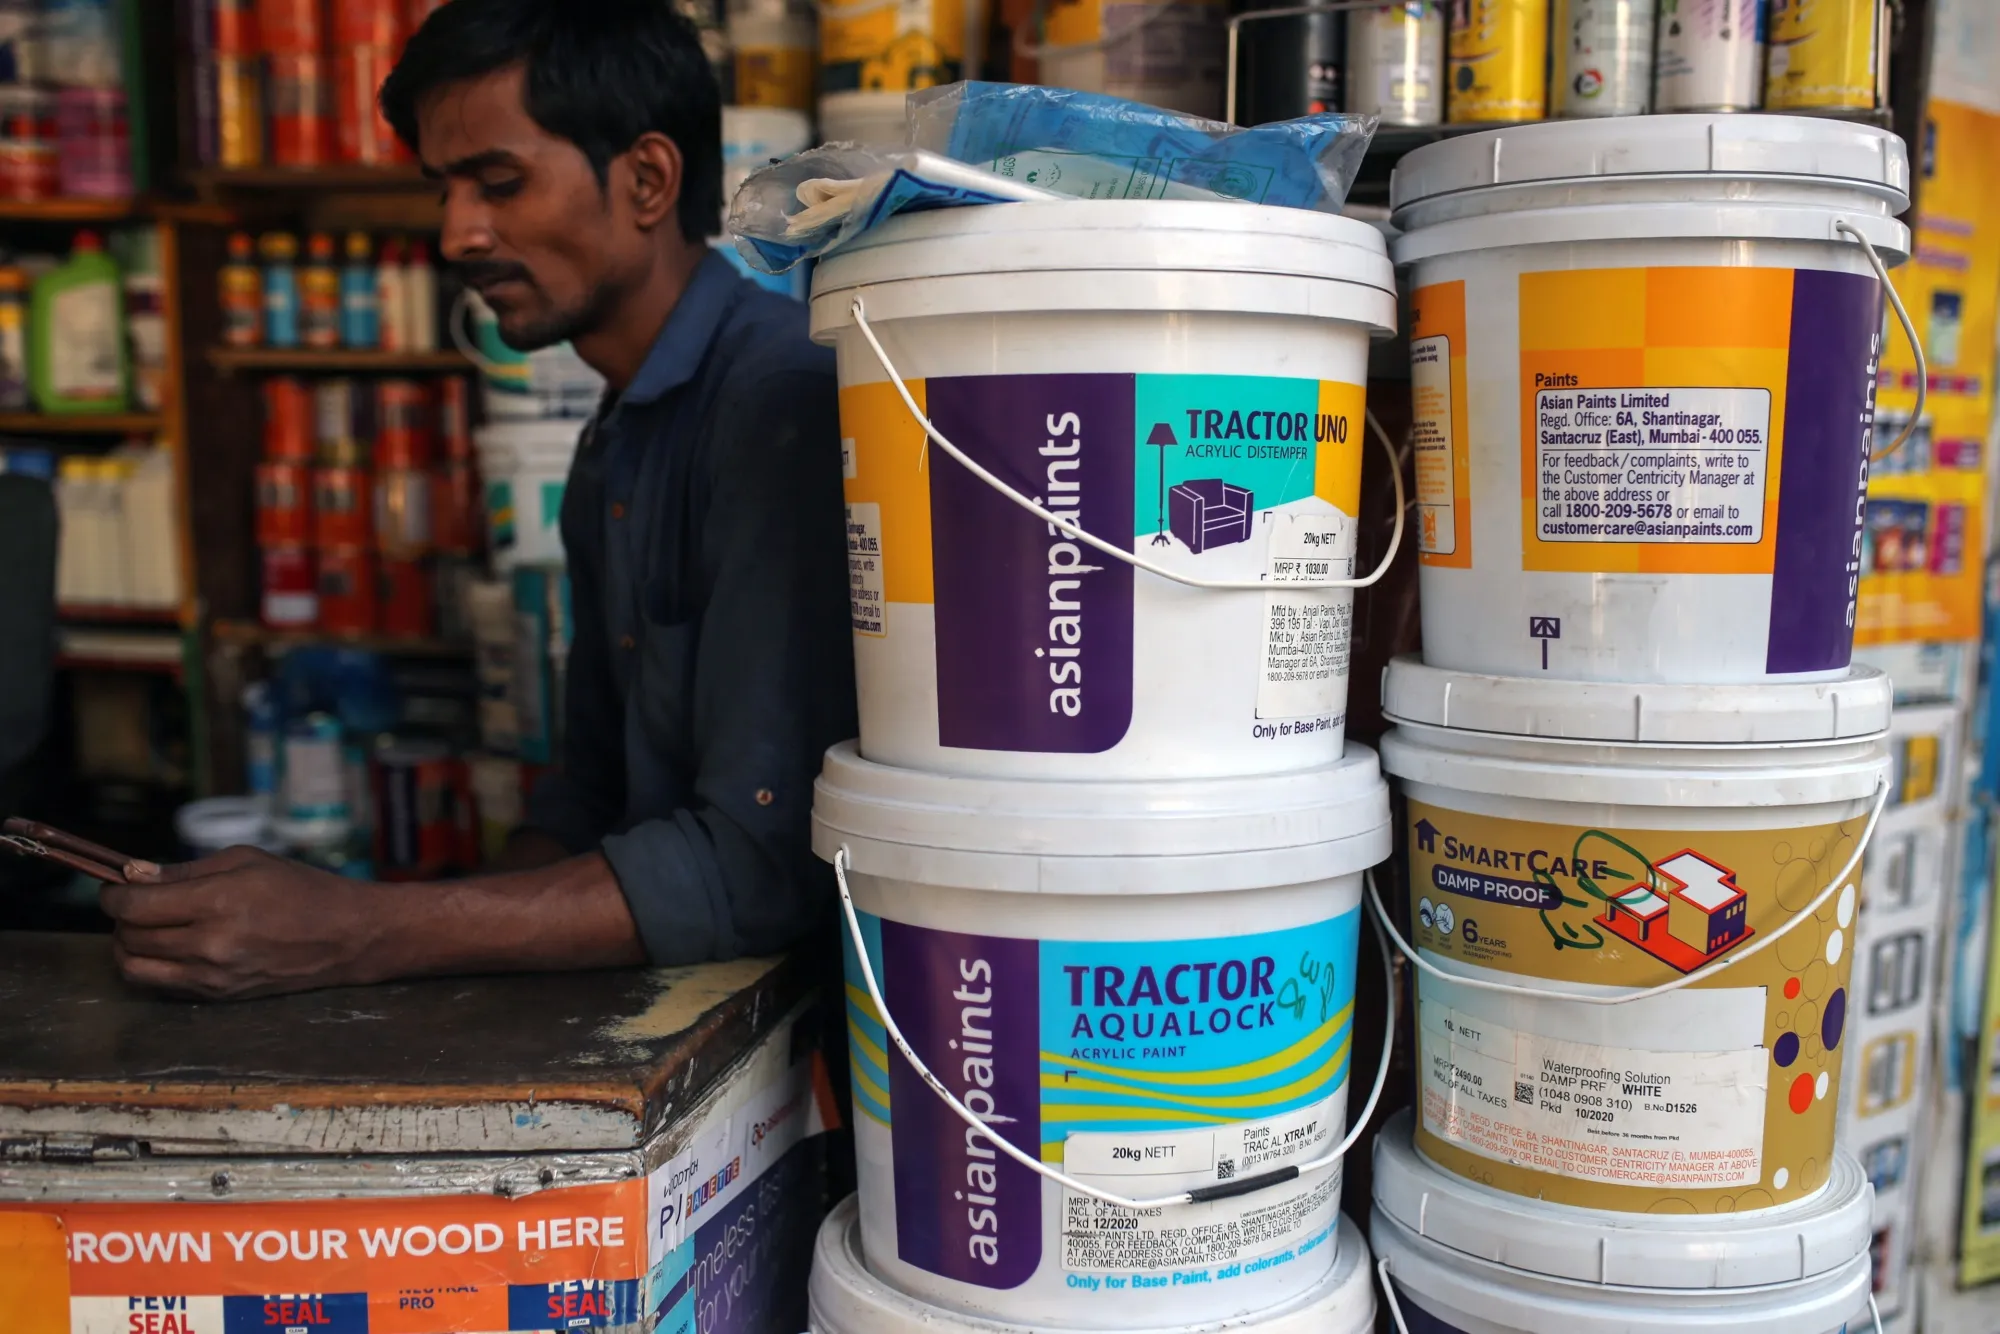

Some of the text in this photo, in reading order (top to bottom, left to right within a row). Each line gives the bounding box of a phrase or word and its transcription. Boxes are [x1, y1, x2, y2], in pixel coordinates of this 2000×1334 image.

[1535, 372, 1578, 387] Paints
[1540, 393, 1669, 409] Asian Paints Limited
[1186, 409, 1348, 444] TRACTOR UNO
[1540, 411, 1722, 430] Regd. Office: 6A, Shantinagar,
[1541, 429, 1762, 447] Santacruz (East), Mumbai 400 055.
[1186, 444, 1308, 460] ACRYLIC DISTEMPER
[1542, 454, 1559, 468] For
[1705, 454, 1735, 468] write
[1738, 454, 1749, 468] to
[1542, 470, 1755, 488] the Customer Centricity Manager at
[1845, 332, 1880, 628] asianpaints
[1542, 487, 1670, 501] the above address or
[1542, 504, 1739, 519] call 1800-209-5678 or email to
[1543, 521, 1753, 538] customercare@asianpaints.com
[1304, 532, 1336, 547] 20kg NETT
[1034, 411, 1104, 717] asianpaints
[1274, 562, 1329, 575] MRP 1030.00
[1271, 605, 1286, 617] Mfd
[1288, 605, 1297, 618] by
[1270, 618, 1300, 630] 396 195
[1269, 630, 1318, 645] Mkt by Asian
[1268, 657, 1300, 671] Manager
[1301, 658, 1308, 668] at
[1267, 670, 1308, 682] 1800-209-5678
[1253, 724, 1277, 740] Only
[1279, 722, 1292, 736] for
[1294, 720, 1314, 734] Base
[1438, 870, 1550, 904] DAMP PROOF
[1462, 918, 1507, 949] 6 YEARS
[1063, 955, 1275, 1008] TRACTOR
[1070, 1000, 1275, 1042] AQUALOCK
[1459, 1026, 1481, 1041] NETT
[1071, 1046, 1187, 1060] ACRYLIC PAINT
[1455, 1067, 1483, 1086] 2490.00
[1542, 1058, 1671, 1085] Waterproofing Solution
[1540, 1072, 1577, 1089] DAMP
[1580, 1080, 1607, 1092] PRF
[1622, 1083, 1662, 1097] WHITE
[1460, 1084, 1508, 1109] ALL TAXES
[1538, 1086, 1633, 1112] (1048 0908 310)
[953, 957, 1019, 1266] asianpaints
[1540, 1100, 1614, 1122] Pkd 10/2020
[1243, 1125, 1270, 1140] Paints
[1243, 1138, 1269, 1154] TRAC
[1271, 1135, 1282, 1147] AL
[1284, 1127, 1305, 1144] XTRA
[1306, 1121, 1318, 1135] WT
[1601, 1130, 1620, 1138] before
[1112, 1145, 1177, 1162] 20kg NETT
[1241, 1153, 1261, 1168] (0013
[1263, 1148, 1281, 1161] W764
[1282, 1143, 1296, 1156] 320)
[1469, 1134, 1745, 1184] 1800-209-5678 OR EMAIL TO CUSTOMERCARE@ASIANPAINTS.COM
[1512, 1138, 1758, 1172] WRITE TO CUSTOMER CENTRICITY MANAGER AT ABOVE
[1612, 1147, 1669, 1160] SANTACRUZ
[1671, 1151, 1686, 1162] (E),
[685, 1156, 740, 1220] PALETTE
[1068, 1198, 1090, 1207] MRP
[1068, 1207, 1162, 1217] INCL. OF ALL TAXES
[1068, 1216, 1139, 1230] Pkd 12/2020
[1100, 1231, 1134, 1241] PAINTS
[1160, 1228, 1189, 1239] REGD.
[1191, 1224, 1226, 1237] OFFICE:
[1105, 1240, 1126, 1250] FOR
[1128, 1238, 1177, 1250] FEEDBACK
[1243, 1223, 1267, 1238] WRITE
[1268, 1219, 1278, 1229] TO
[1279, 1206, 1312, 1226] CUSTOMER
[223, 1228, 349, 1262] YOUR
[358, 1222, 504, 1258] WOOD
[517, 1216, 625, 1251] HERE
[1067, 1220, 1302, 1259] AT ABOVE ADDRESS OR CALL 1800-209-5678 OR EMAIL TO
[1067, 1249, 1238, 1269] CUSTOMERCARE@ASIANPAINTS.COM
[1066, 1250, 1296, 1291] Only for Base Paint, add colorants,
[399, 1296, 434, 1310] PRO
[548, 1292, 611, 1318] SEAL
[263, 1301, 331, 1325] SEAL
[128, 1313, 195, 1334] SEAL
